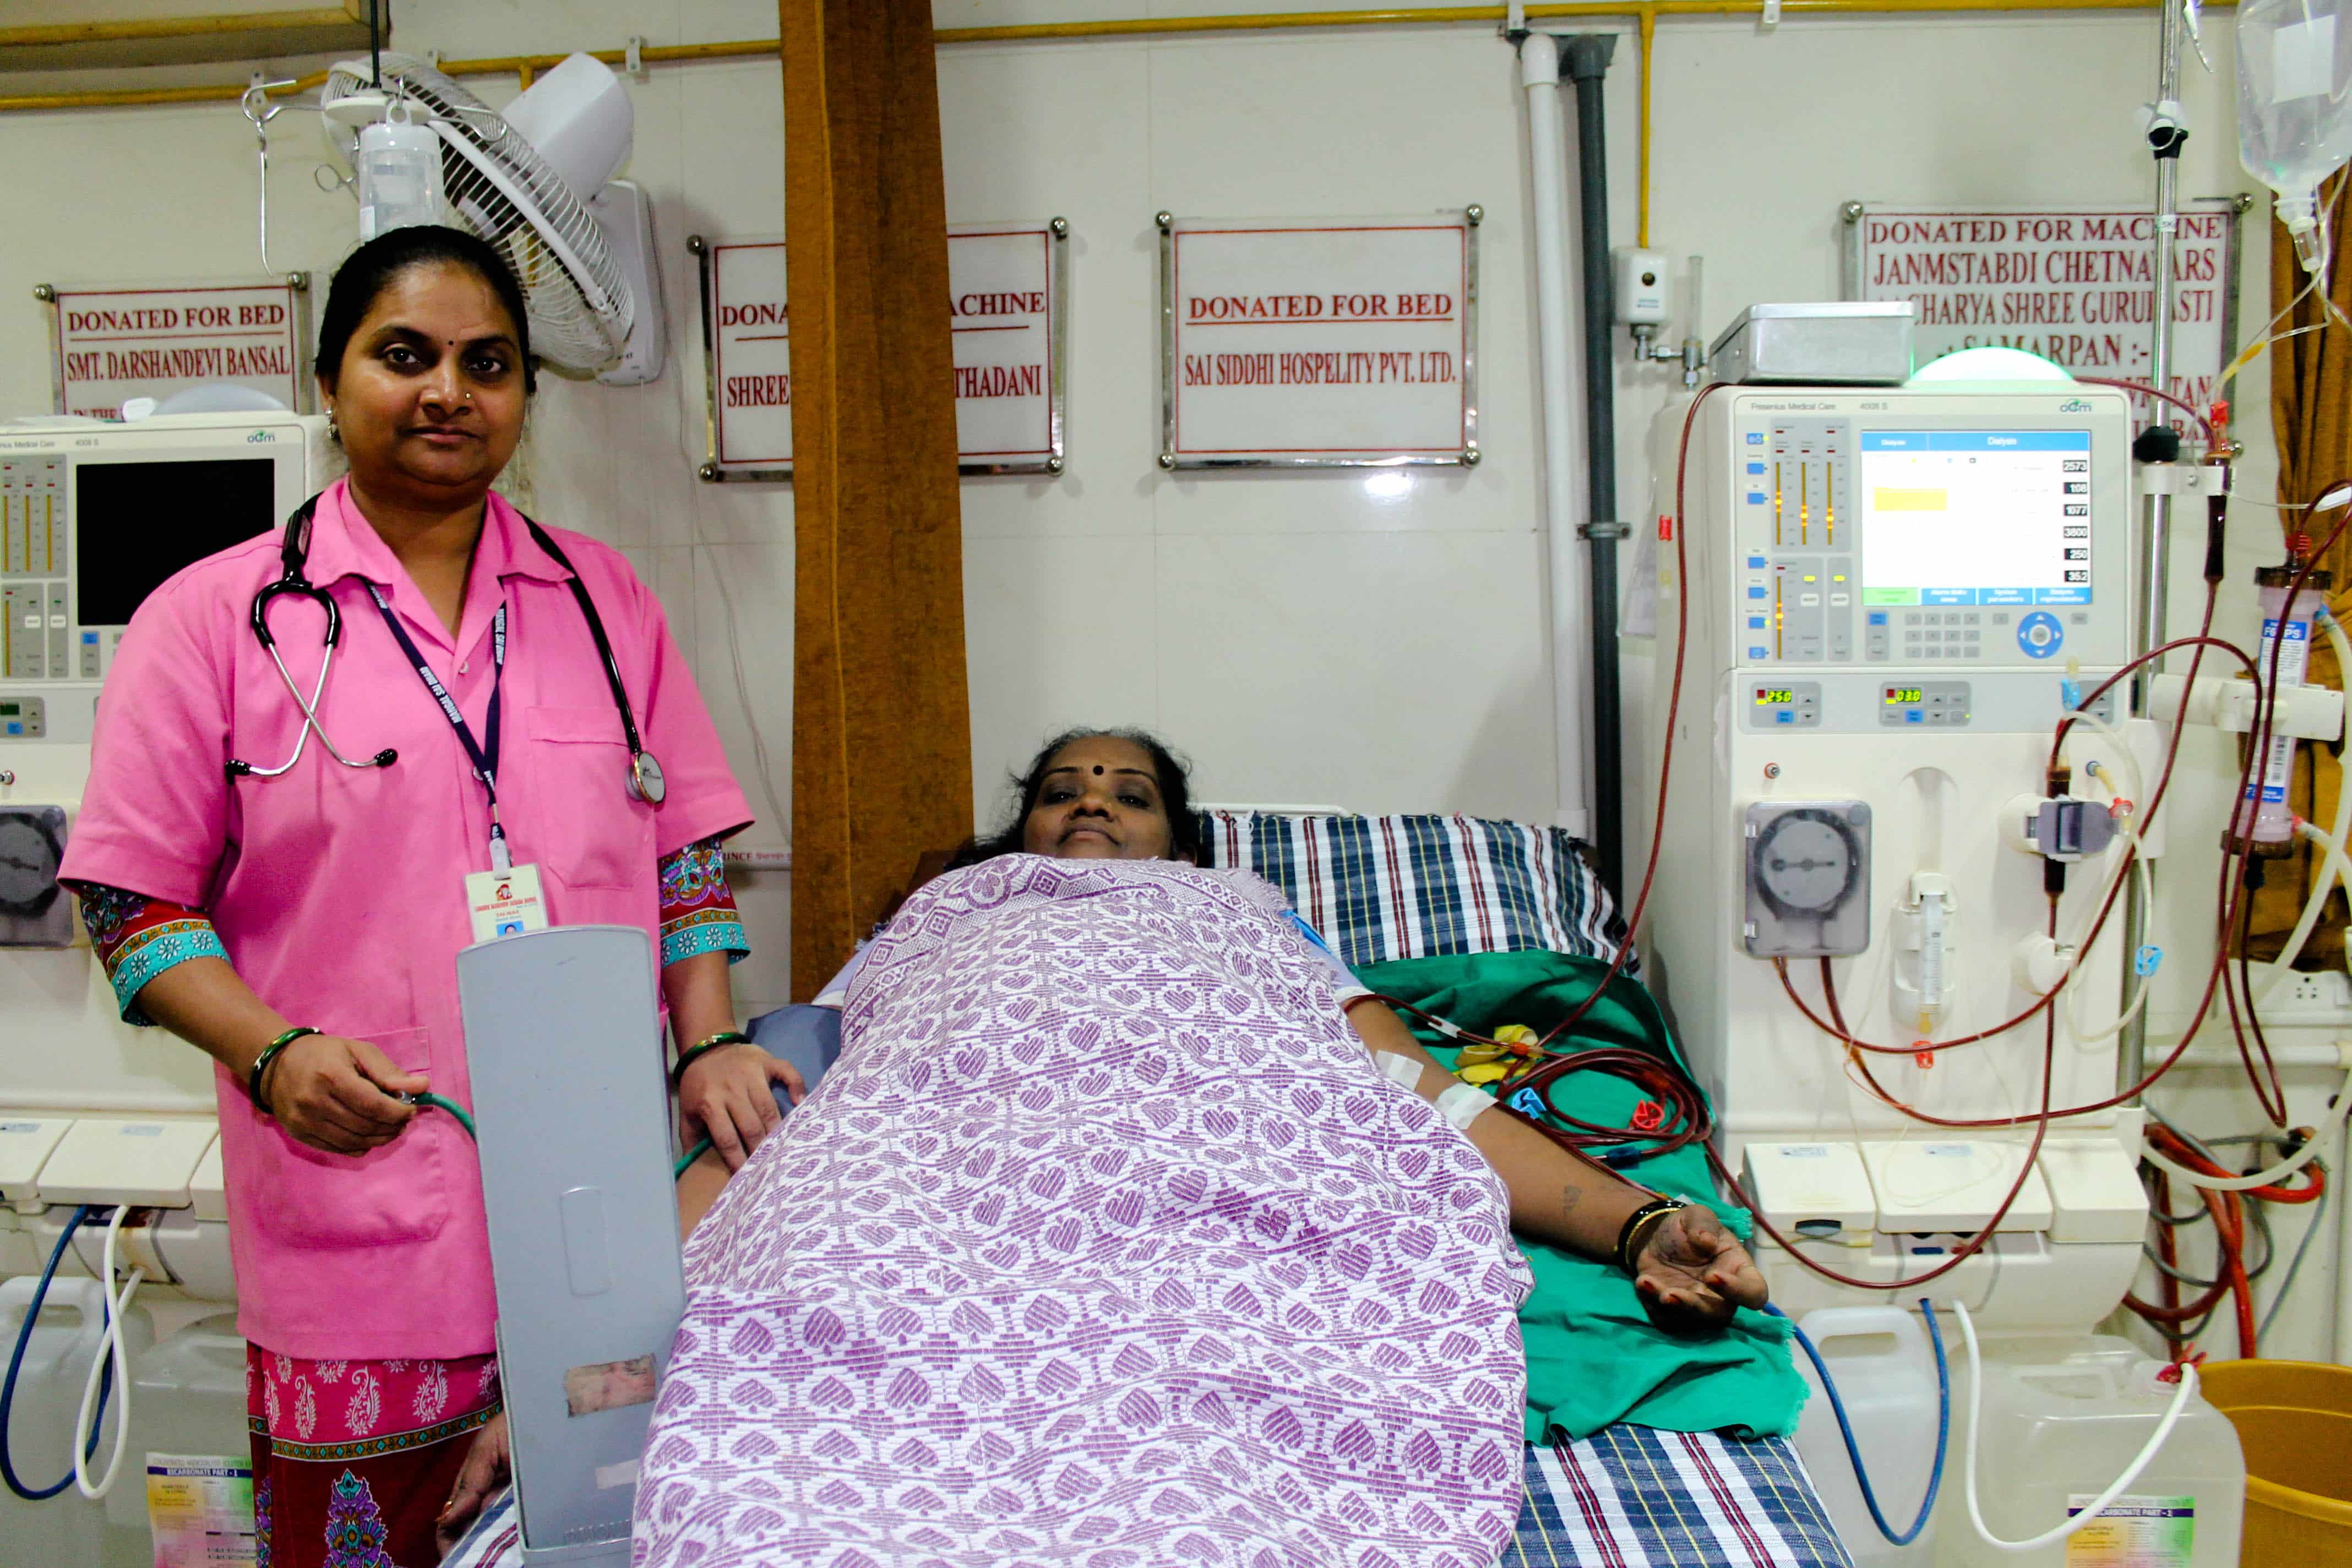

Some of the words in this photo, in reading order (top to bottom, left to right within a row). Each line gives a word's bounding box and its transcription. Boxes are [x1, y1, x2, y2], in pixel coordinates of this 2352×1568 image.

[1870, 220, 2007, 244] DONATED
[2016, 220, 2072, 242] FOR
[2082, 217, 2221, 241] MACINE
[1873, 252, 2039, 286] JANMSTABDI
[67, 308, 178, 331] DONATED
[184, 305, 232, 328] FOR
[238, 304, 285, 325] BED
[722, 303, 789, 326] DONA
[951, 292, 1045, 316] CHINE
[1189, 295, 1322, 319] DONATED
[1331, 295, 1389, 317] FOR
[1396, 294, 1452, 316] BED
[2001, 292, 2075, 325] SHREE
[67, 352, 104, 382] SMT.
[107, 348, 222, 380] DARSHANDEVI
[226, 346, 290, 375] BANSAL
[1185, 353, 1212, 385] SAI
[1216, 353, 1274, 385] SIDDHI
[1280, 351, 1376, 384] HOSPELITY
[1379, 352, 1415, 384] PVT.
[1419, 351, 1456, 383] LTD.
[727, 374, 790, 407] SHREE
[1767, 691, 1792, 703] 250
